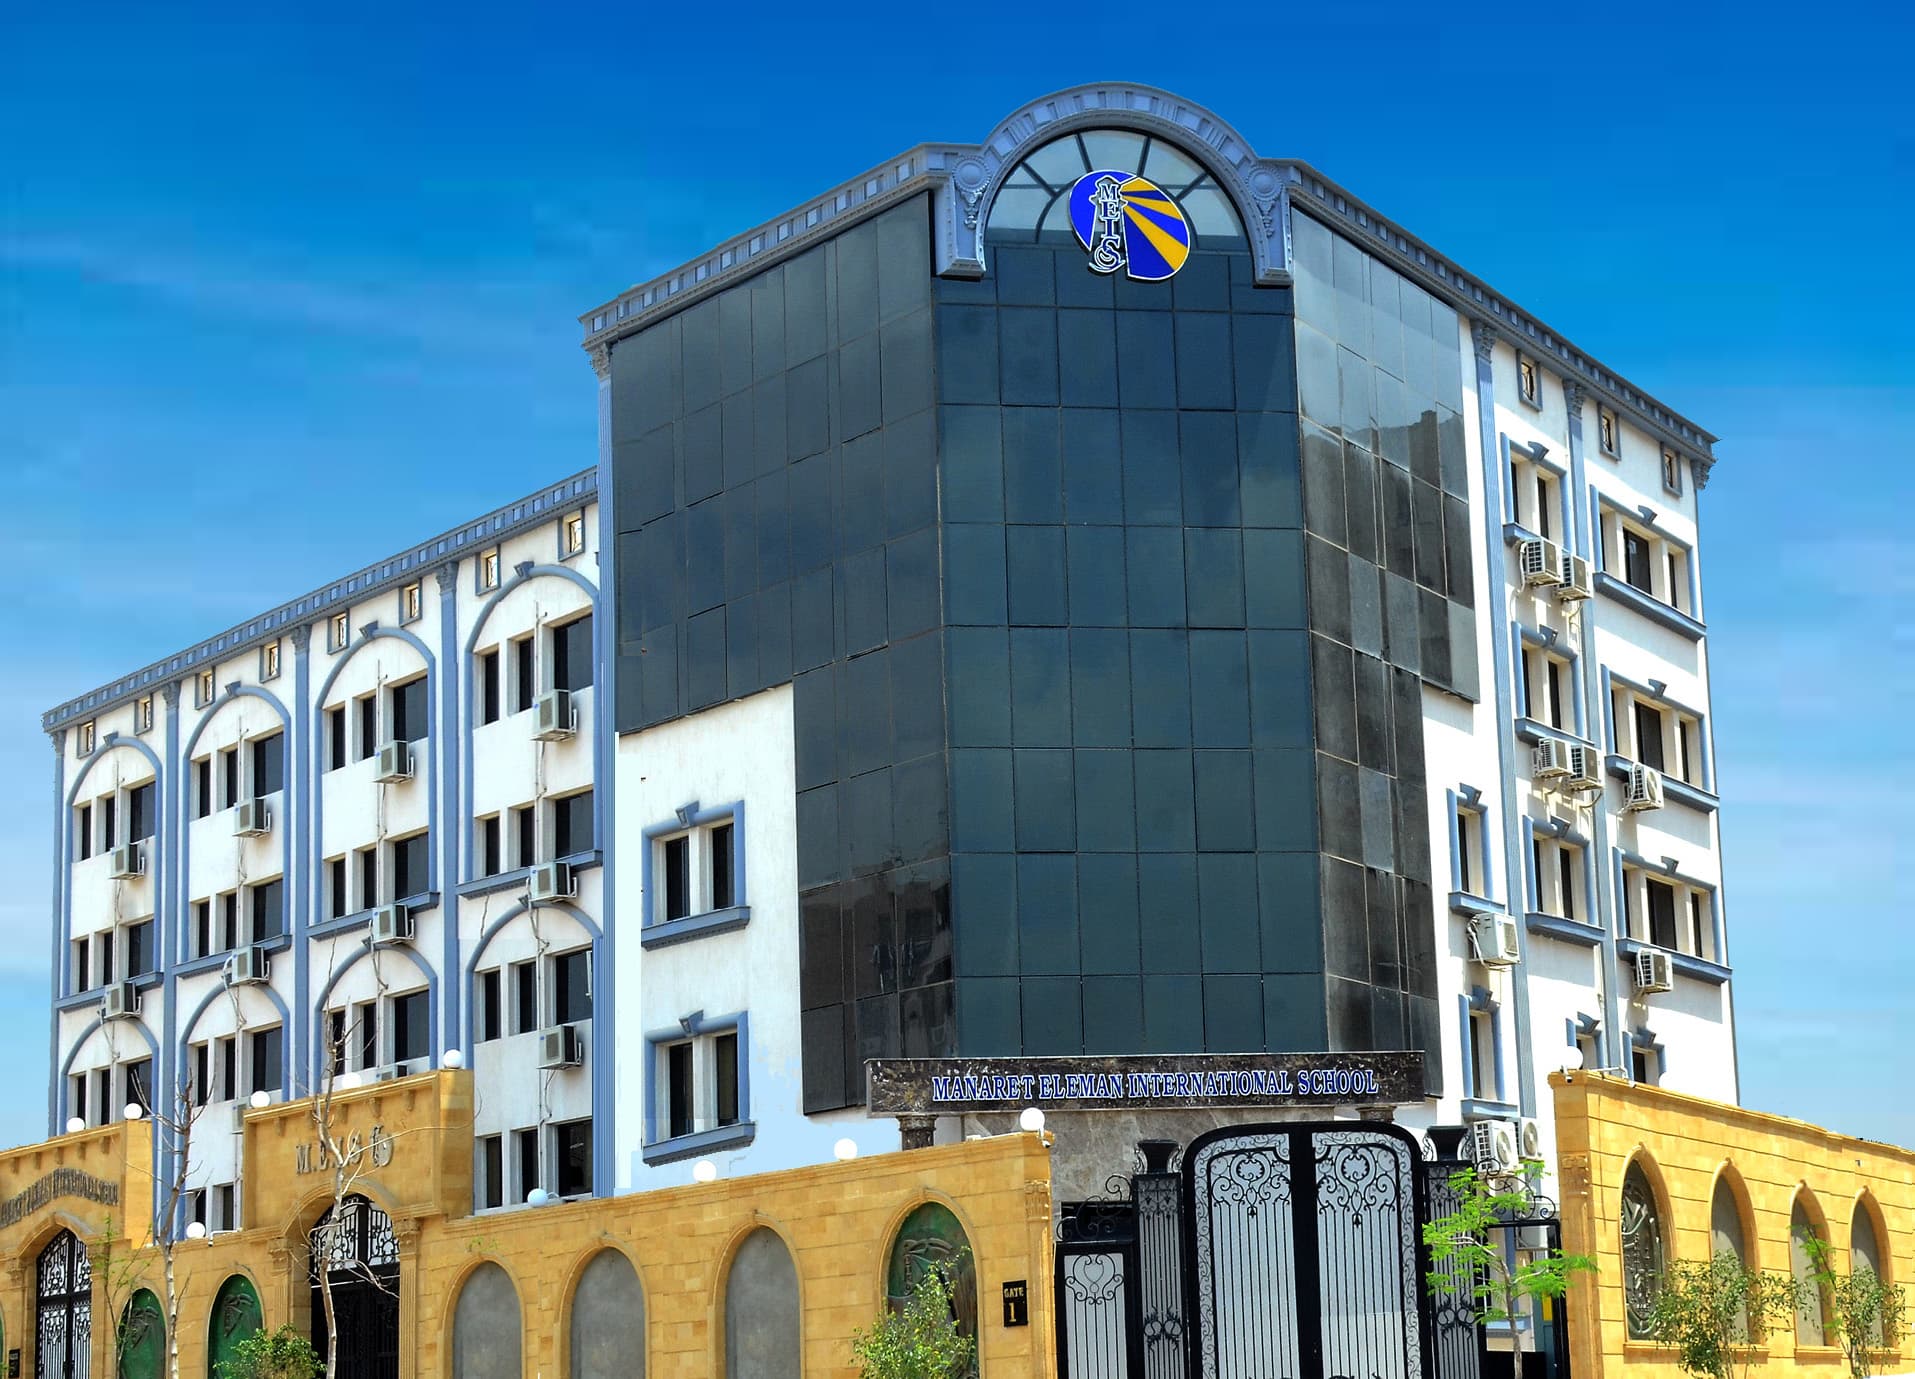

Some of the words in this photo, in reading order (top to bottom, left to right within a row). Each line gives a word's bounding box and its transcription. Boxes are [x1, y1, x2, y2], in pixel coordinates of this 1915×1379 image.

[1091, 183, 1124, 272] MEIS
[932, 1075, 1035, 1101] MANARET
[1039, 1073, 1124, 1099] ELEMAN
[1128, 1071, 1293, 1098] INTERNATIONAL
[1298, 1070, 1379, 1095] SCHOOL
[1003, 1287, 1024, 1298] GATE
[1008, 1302, 1017, 1322] 1
